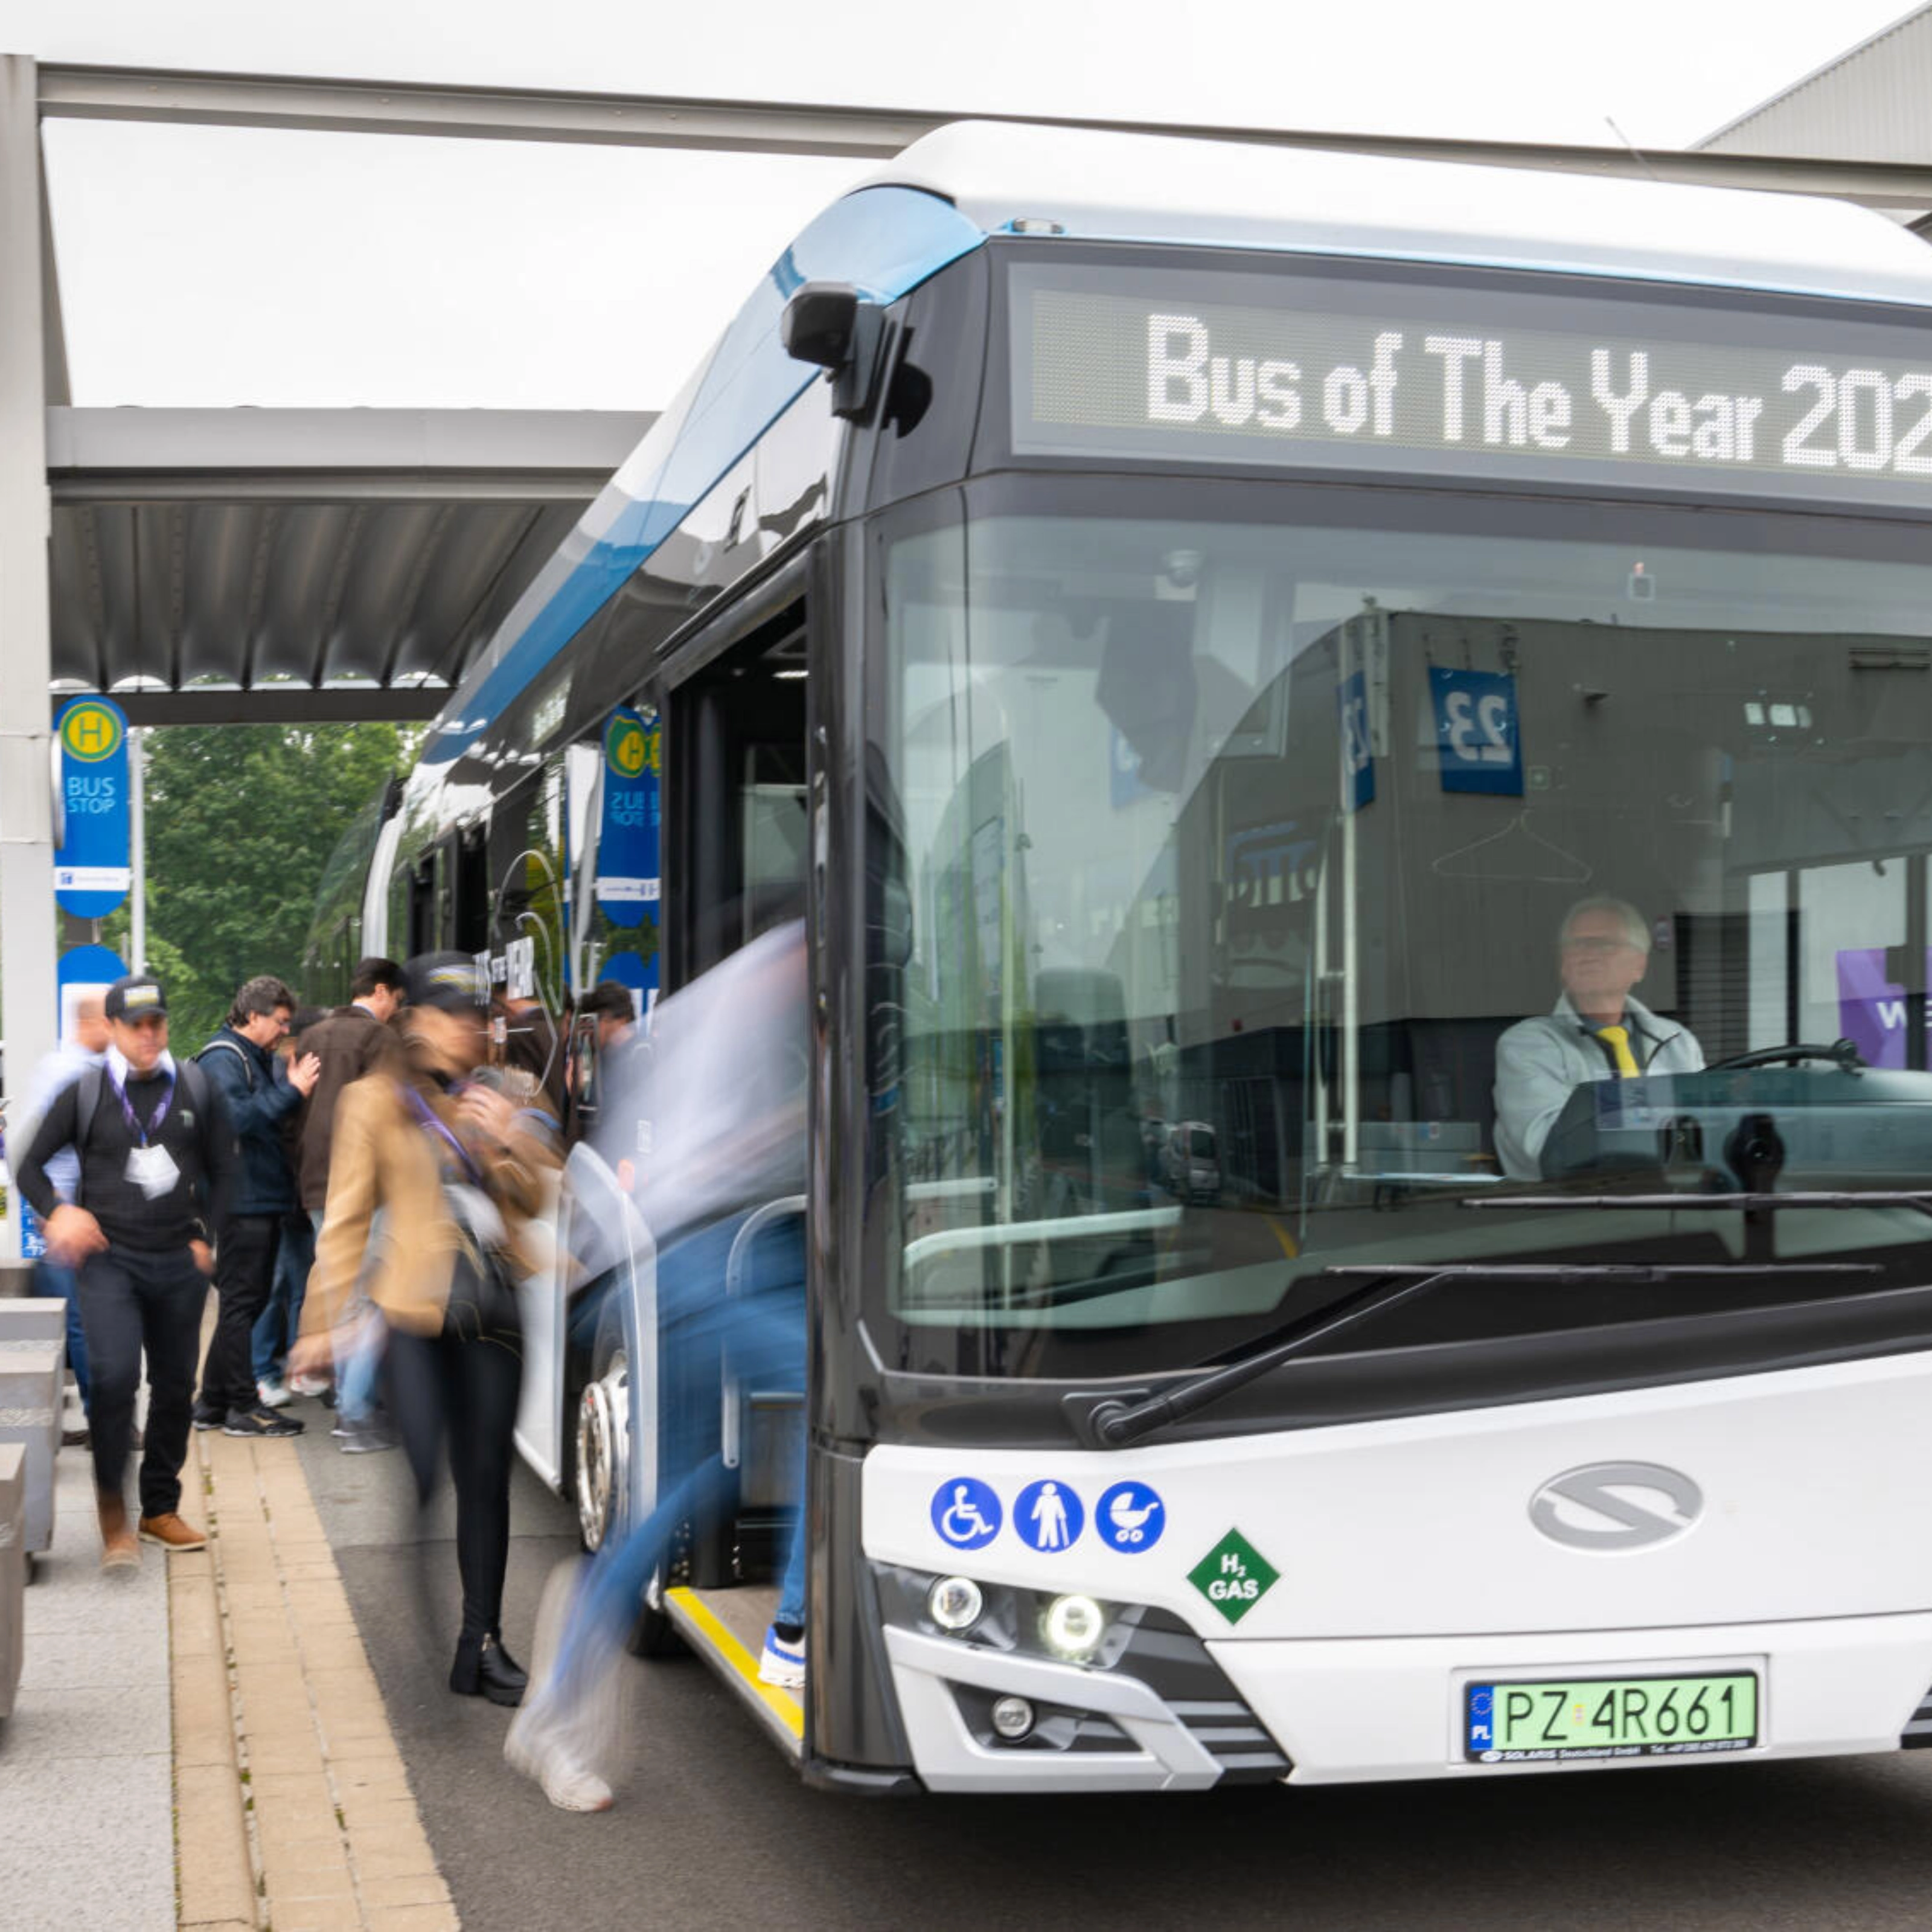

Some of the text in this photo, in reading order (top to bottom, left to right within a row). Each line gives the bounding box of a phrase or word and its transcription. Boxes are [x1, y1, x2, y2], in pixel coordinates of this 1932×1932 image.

[1148, 314, 1302, 429] Bus
[1323, 331, 1403, 435] of
[1425, 336, 1571, 448] The
[1591, 349, 1763, 461] Year
[79, 716, 103, 749] H
[68, 776, 116, 798] BUS
[68, 798, 116, 814] STOP
[1208, 1579, 1259, 1600] GAS
[1507, 1684, 1734, 1742] PZ 4R661
[1471, 1725, 1491, 1740] PL
